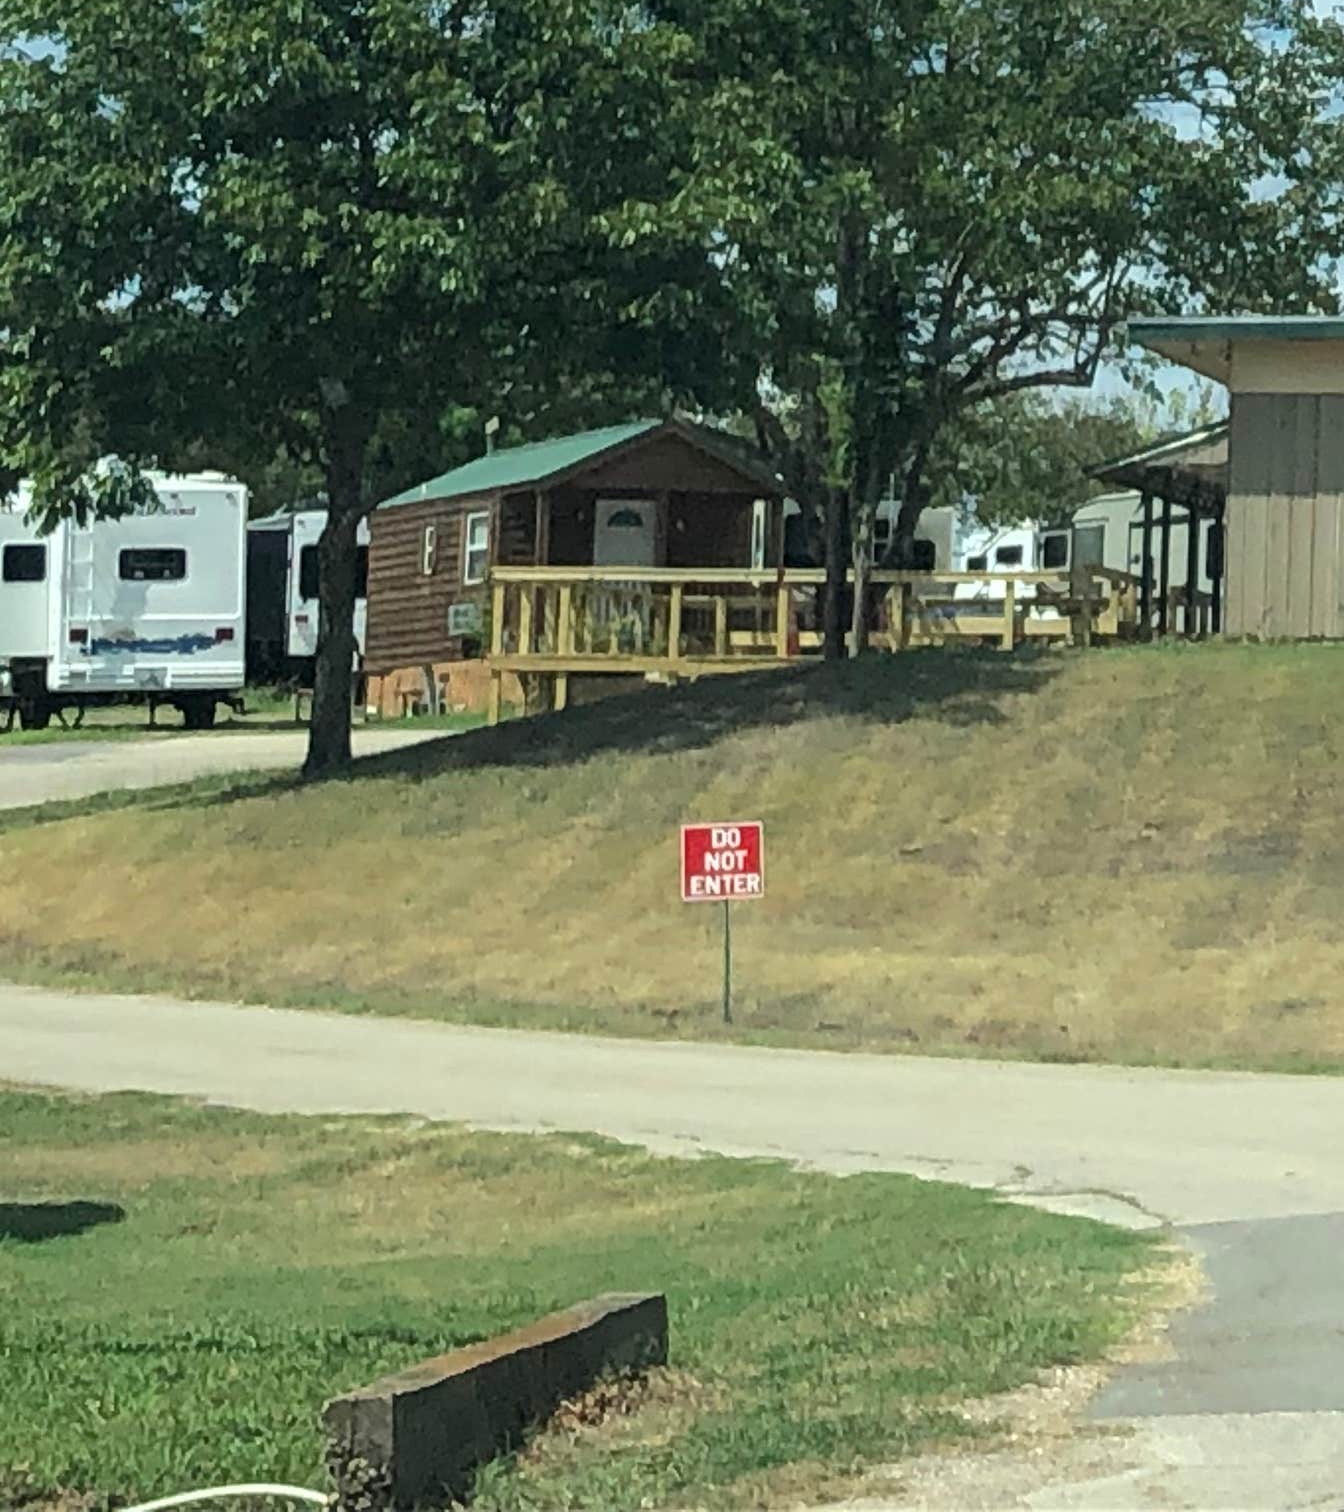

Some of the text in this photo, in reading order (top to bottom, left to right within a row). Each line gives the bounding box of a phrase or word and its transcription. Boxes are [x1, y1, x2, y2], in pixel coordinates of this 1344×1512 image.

[711, 828, 741, 849] DO
[704, 850, 748, 871] NOT
[690, 873, 760, 894] ENTER
